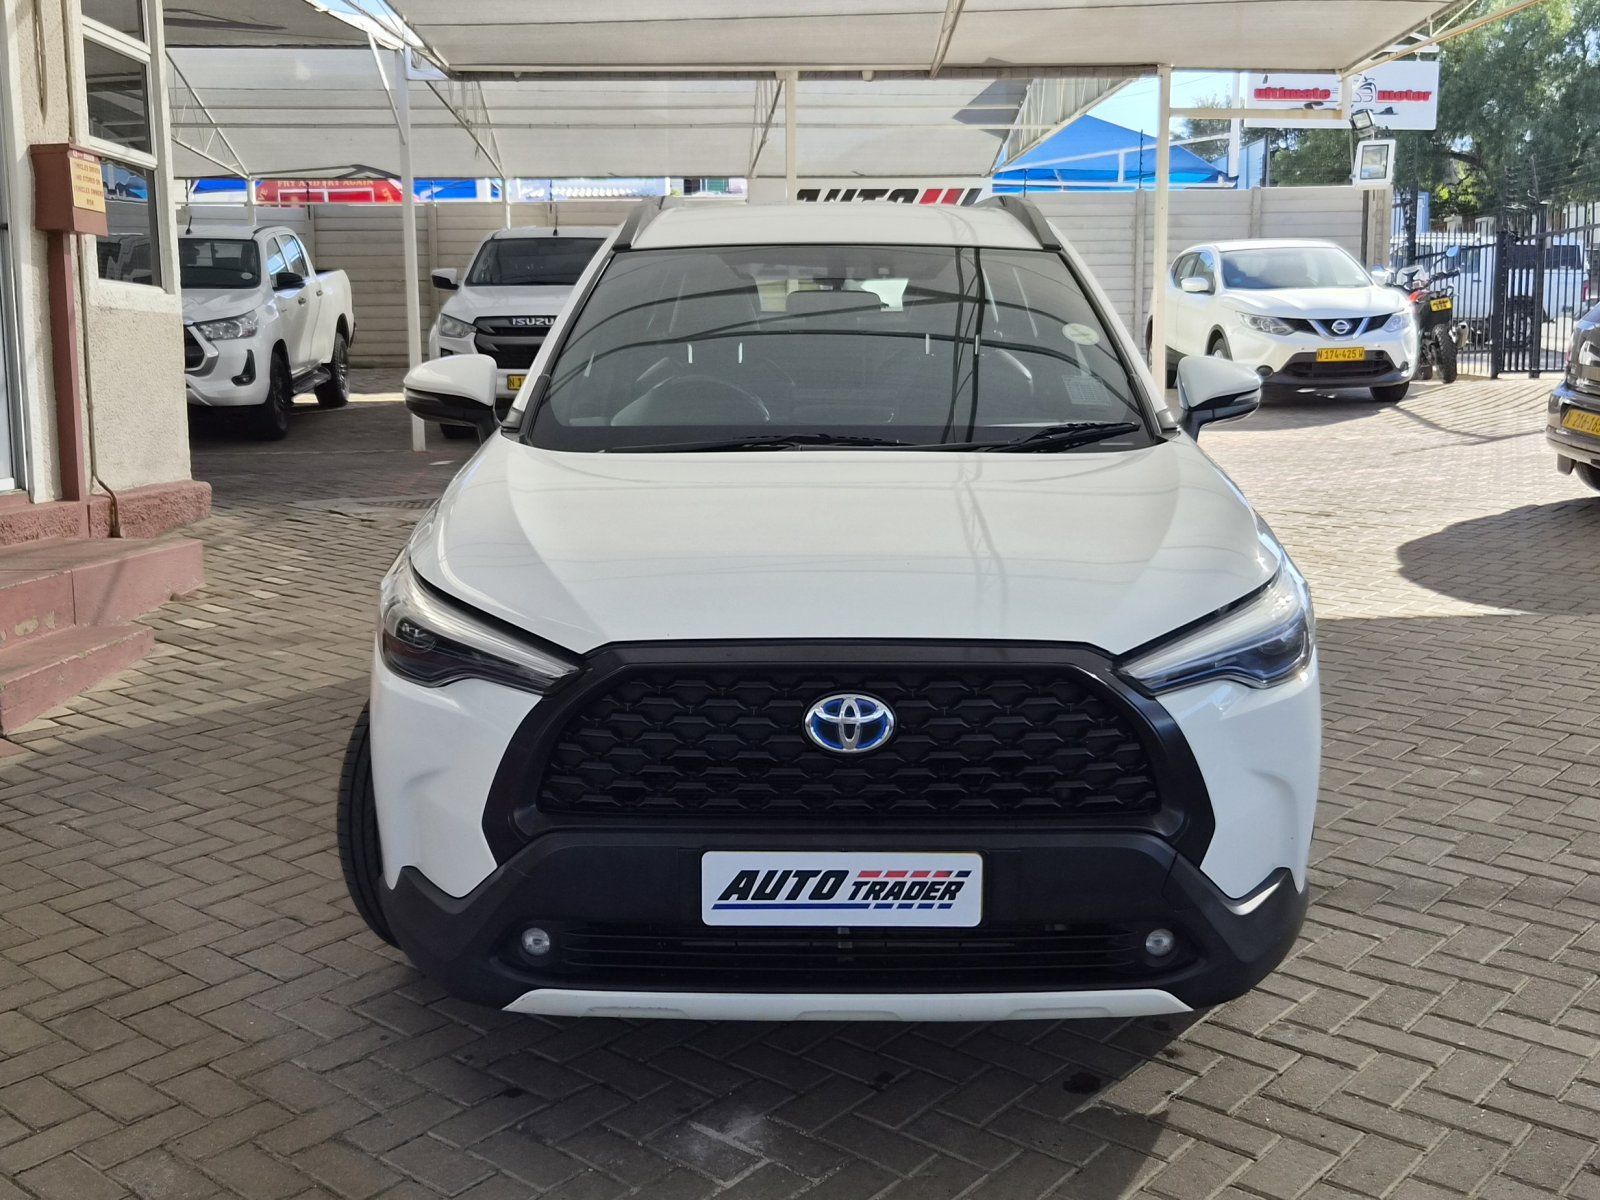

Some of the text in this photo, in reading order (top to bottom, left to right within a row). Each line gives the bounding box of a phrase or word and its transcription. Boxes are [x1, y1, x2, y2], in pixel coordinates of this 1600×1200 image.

[1254, 86, 1432, 101] ultimate motor
[512, 317, 554, 326] ISUZU
[716, 869, 965, 901] AUTO TRADER
